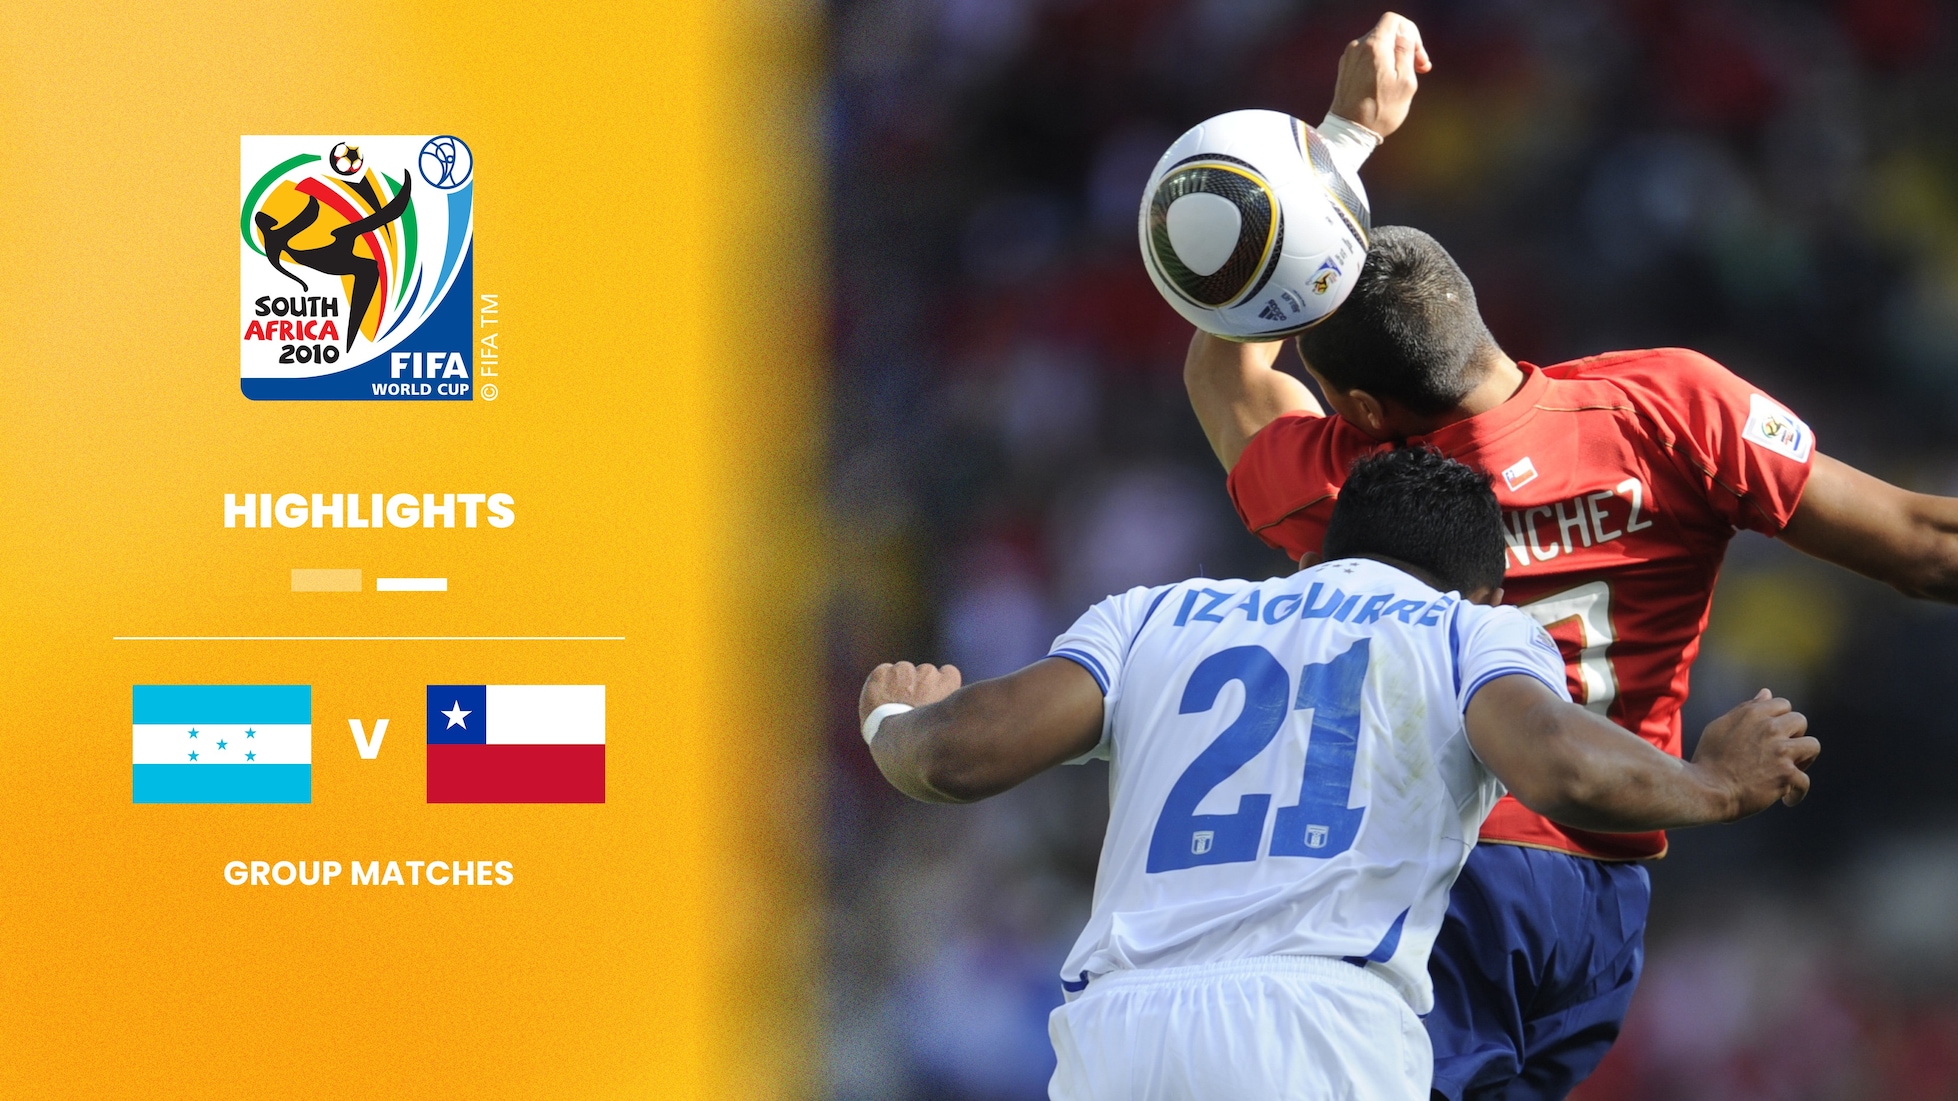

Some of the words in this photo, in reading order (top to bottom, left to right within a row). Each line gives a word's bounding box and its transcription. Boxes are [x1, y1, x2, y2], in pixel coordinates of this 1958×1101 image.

[1504, 477, 1653, 570] NCHEZ
[1173, 582, 1455, 627] IZAGUIRRE
[1146, 637, 1371, 874] 21
